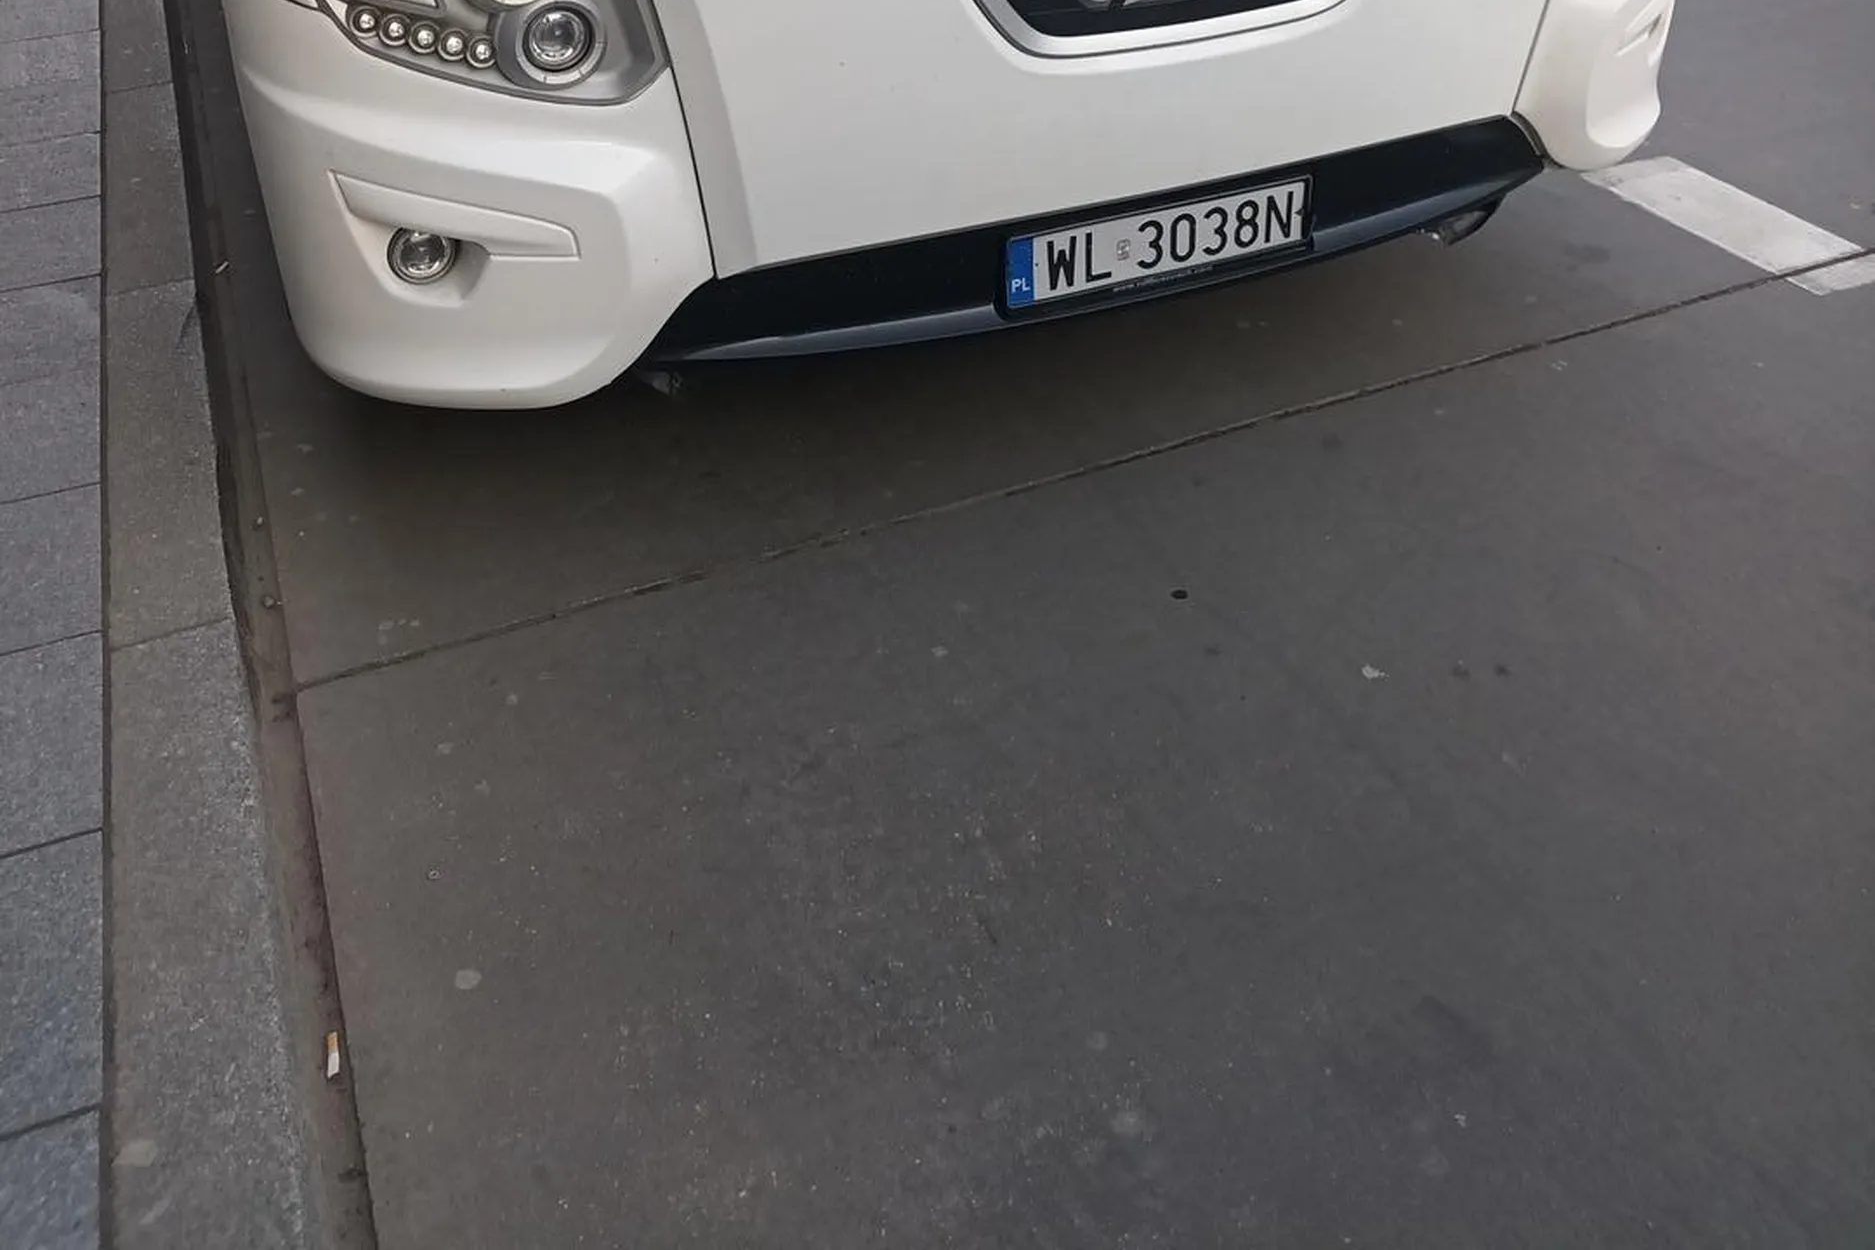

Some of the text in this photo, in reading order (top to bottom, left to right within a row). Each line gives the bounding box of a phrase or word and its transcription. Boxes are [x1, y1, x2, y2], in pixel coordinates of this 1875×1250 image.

[1046, 190, 1295, 291] WL 3038N
[1010, 277, 1031, 293] PL
